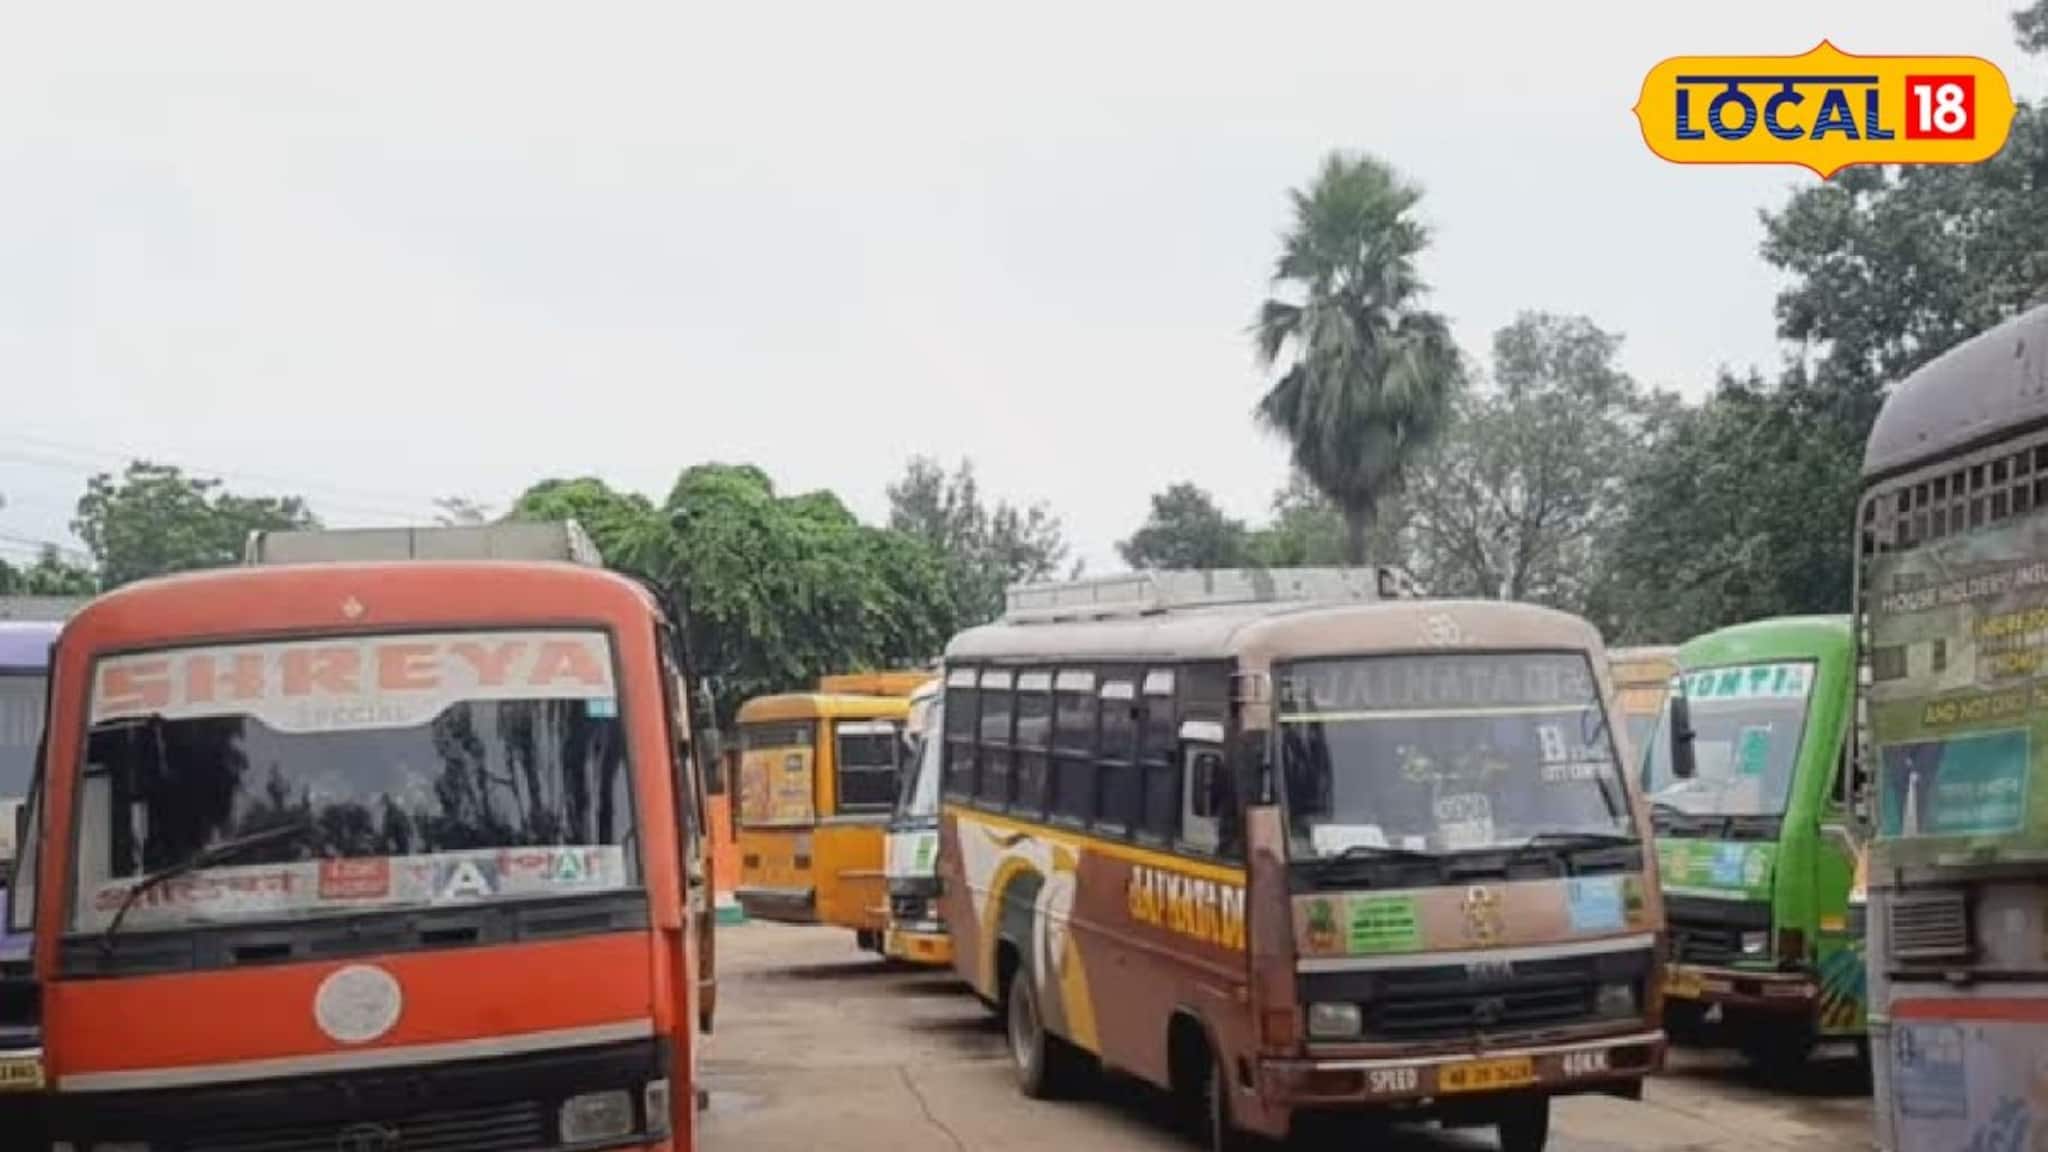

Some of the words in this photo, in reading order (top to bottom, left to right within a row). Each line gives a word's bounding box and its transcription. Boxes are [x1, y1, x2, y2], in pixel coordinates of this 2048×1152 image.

[101, 638, 607, 712] SHREYA
[441, 858, 493, 899] A
[1369, 1067, 1419, 1092] SPEED
